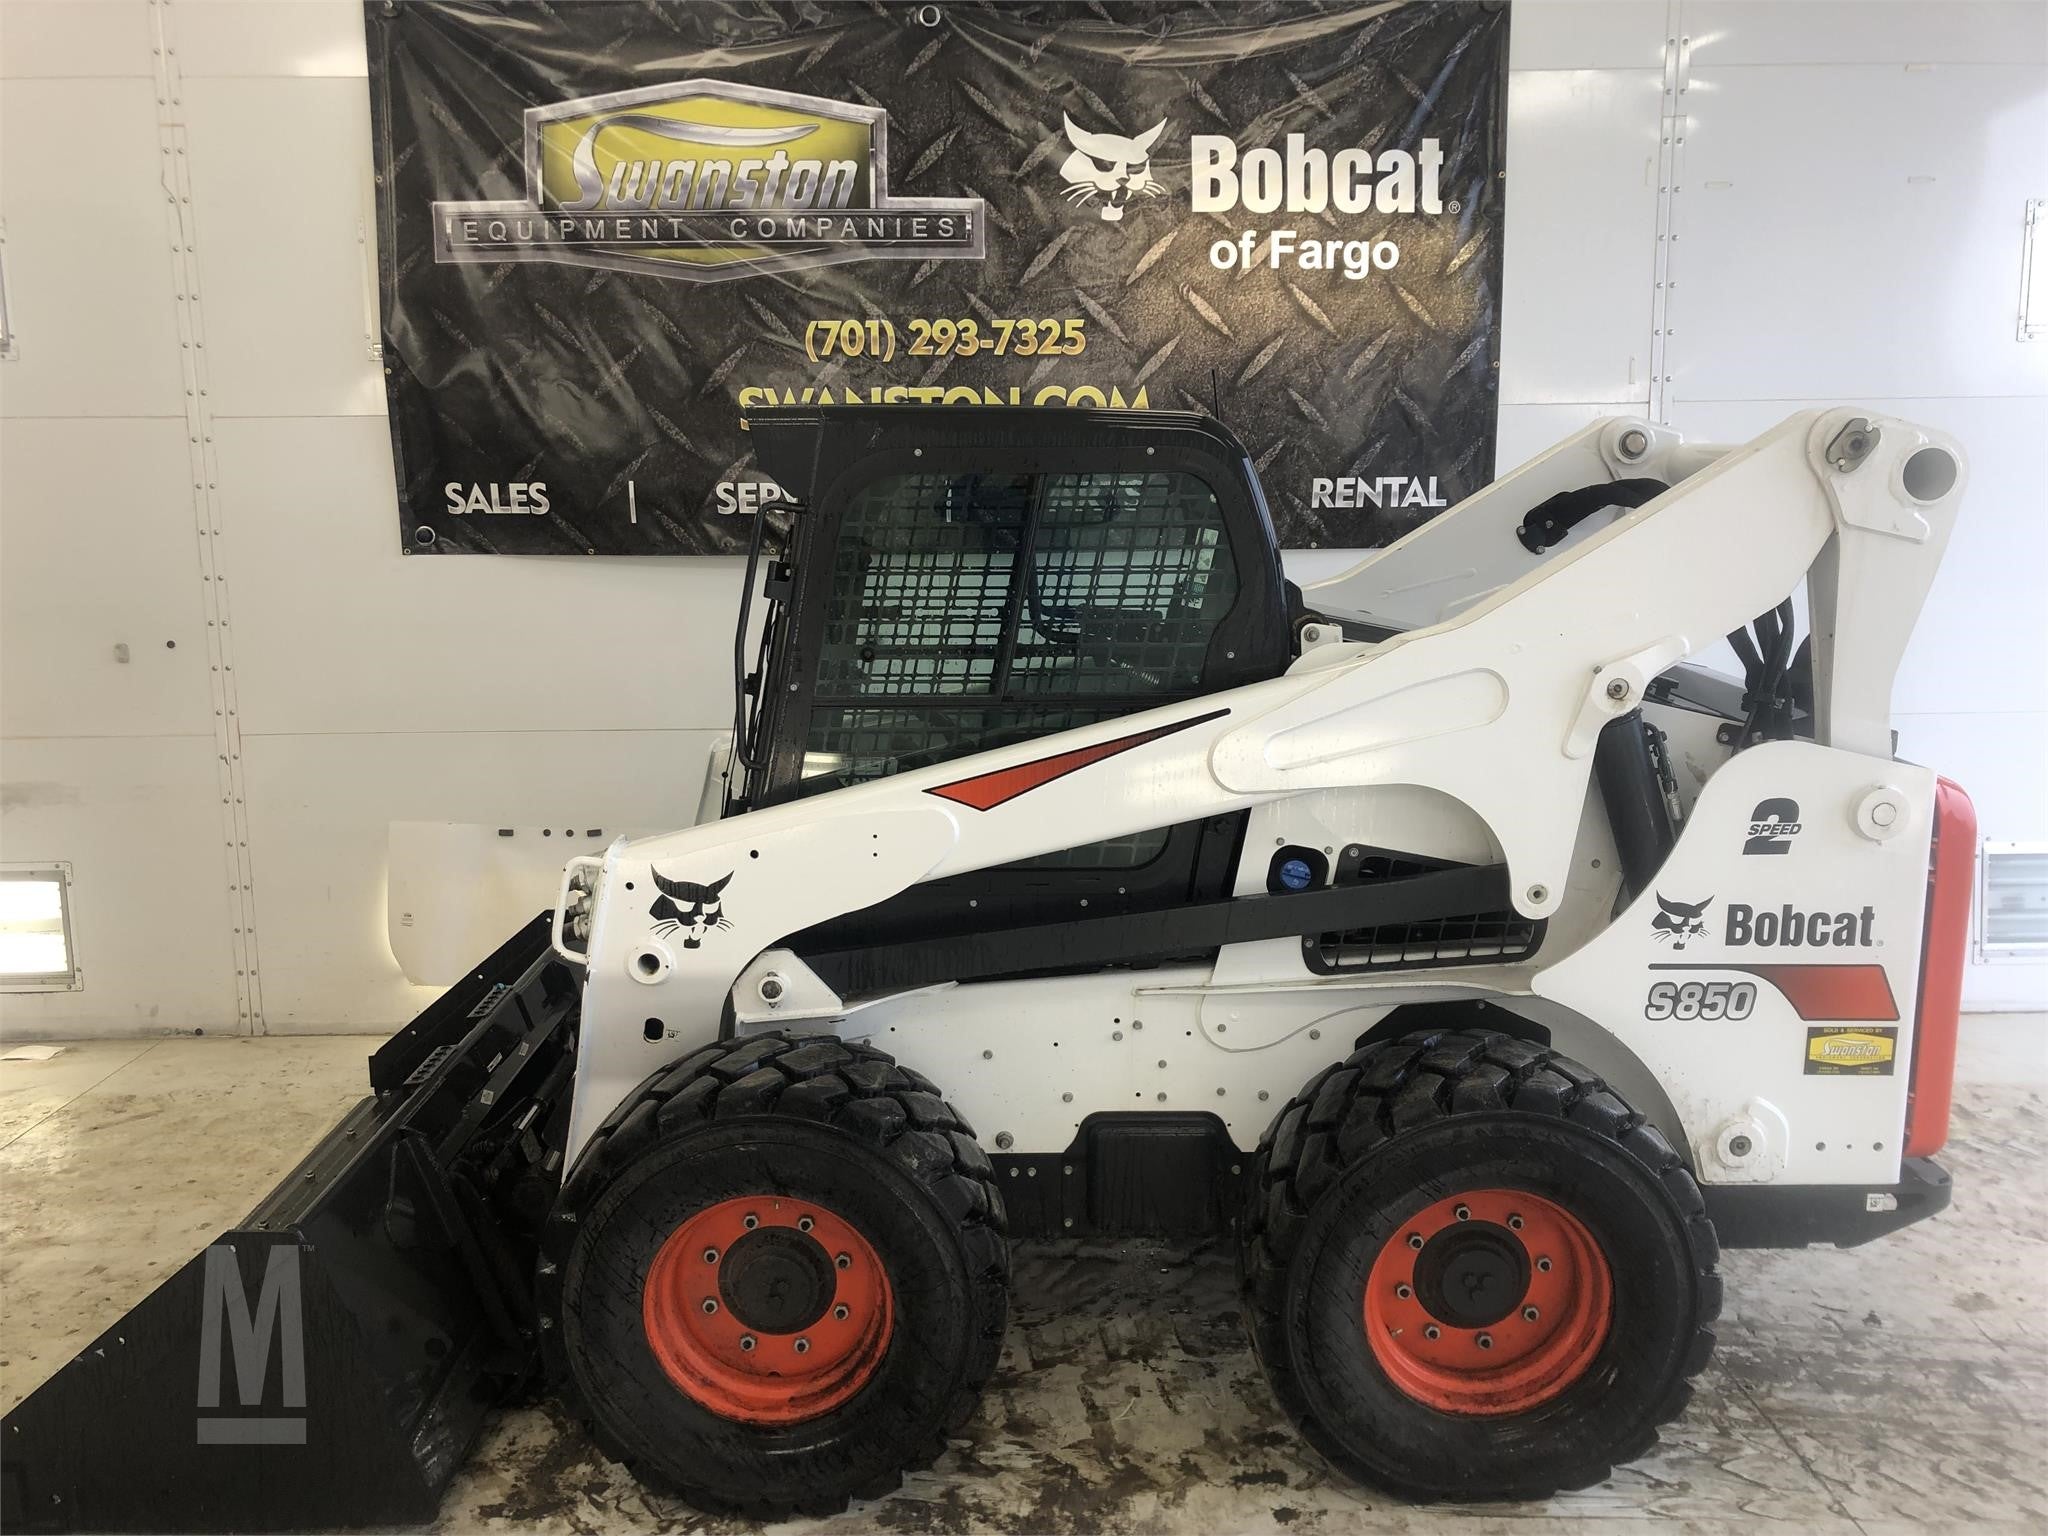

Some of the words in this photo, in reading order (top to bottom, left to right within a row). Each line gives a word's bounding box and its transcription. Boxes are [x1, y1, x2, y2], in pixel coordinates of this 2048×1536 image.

[558, 113, 858, 210] Swanston
[462, 218, 684, 242] EQUIPMENT
[729, 217, 956, 240] COMPANIES
[1209, 229, 1257, 270] of
[1270, 230, 1401, 280] Fargo
[804, 319, 896, 363] (701)
[907, 317, 1087, 357] 293-7325
[444, 482, 551, 515] SALES
[1311, 475, 1448, 509] RENTAL
[1747, 822, 1803, 837] SPEED
[1645, 981, 1757, 1021] S850
[1822, 1038, 1881, 1056] Swanston
